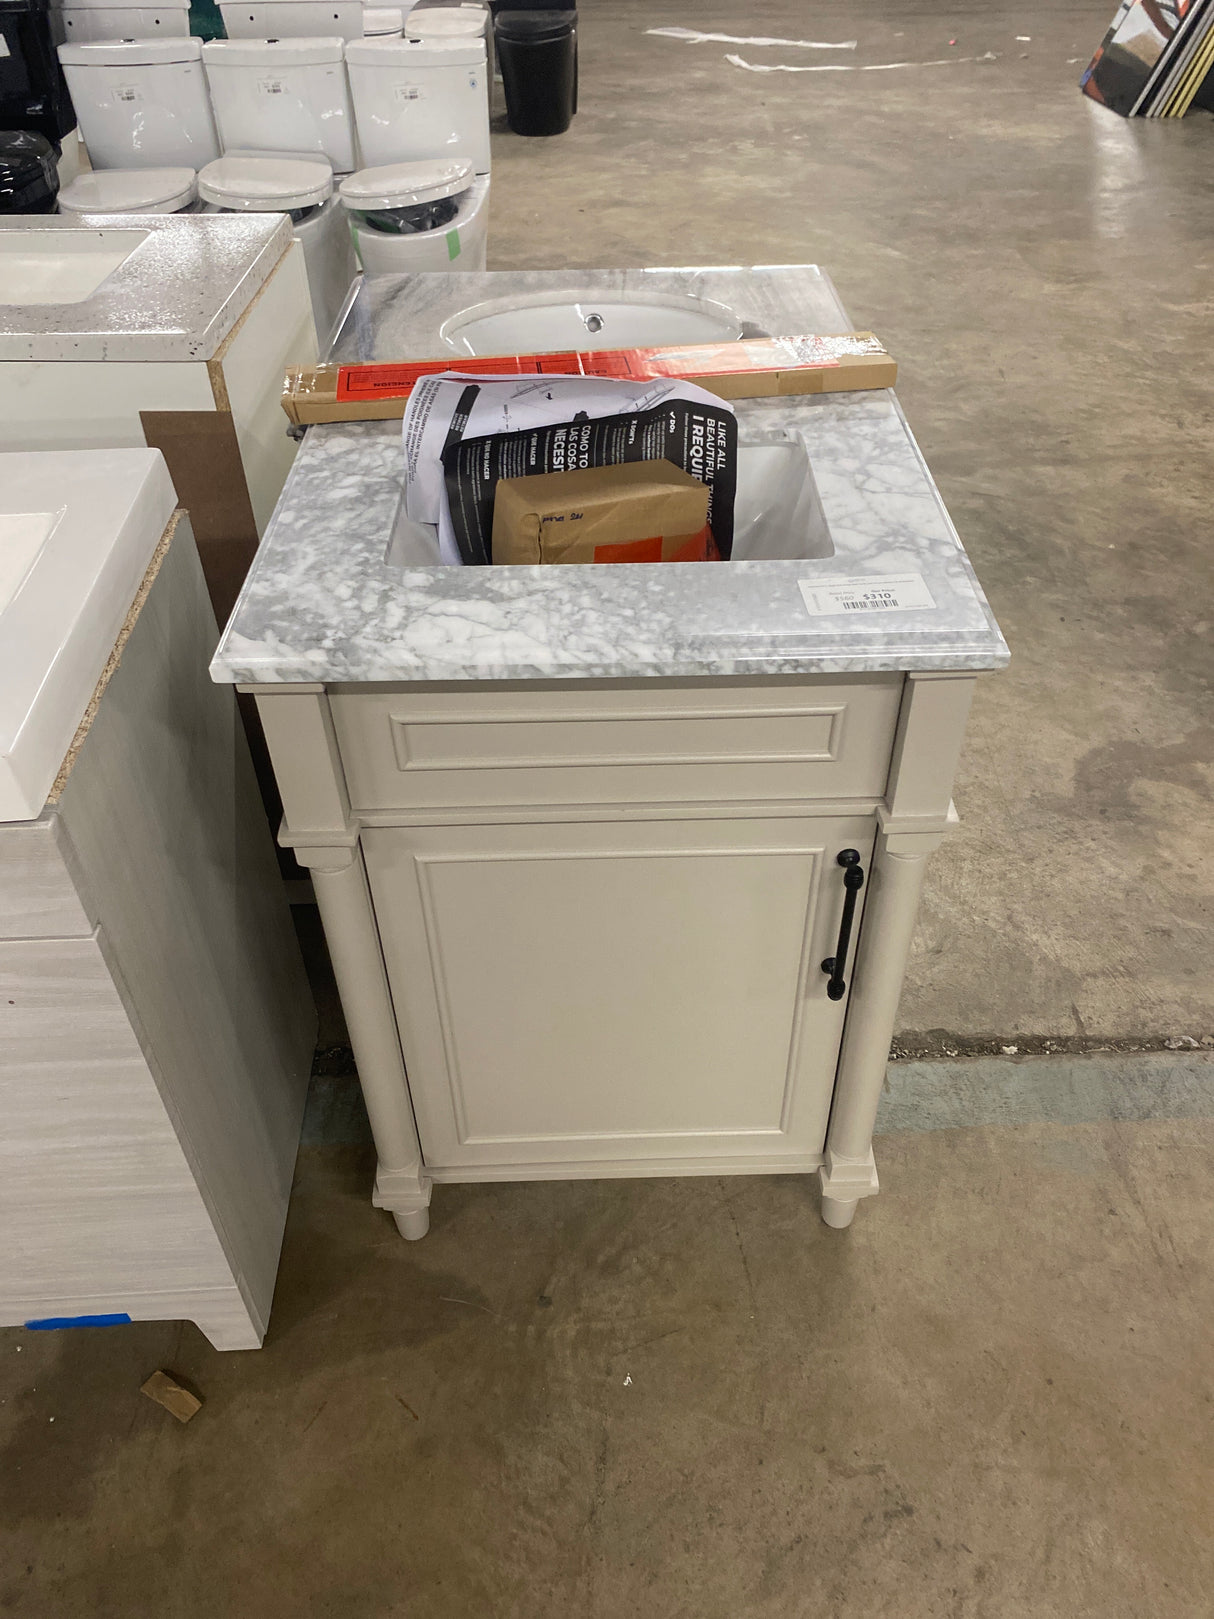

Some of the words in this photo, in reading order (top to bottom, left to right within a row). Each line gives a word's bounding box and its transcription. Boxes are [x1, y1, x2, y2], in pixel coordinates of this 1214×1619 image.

[410, 398, 421, 422] HANDLES
[425, 405, 431, 413] DE
[427, 392, 437, 405] ASAS
[416, 413, 429, 450] INTERCAMBIO
[569, 426, 580, 442] LAS
[579, 425, 592, 451] COMO
[716, 421, 727, 448] LIKE
[705, 417, 716, 481] BEAUTIFUL
[716, 448, 726, 470] ALL
[483, 459, 491, 480] HACER
[705, 484, 714, 525] THINGS
[862, 592, 892, 601] $310
